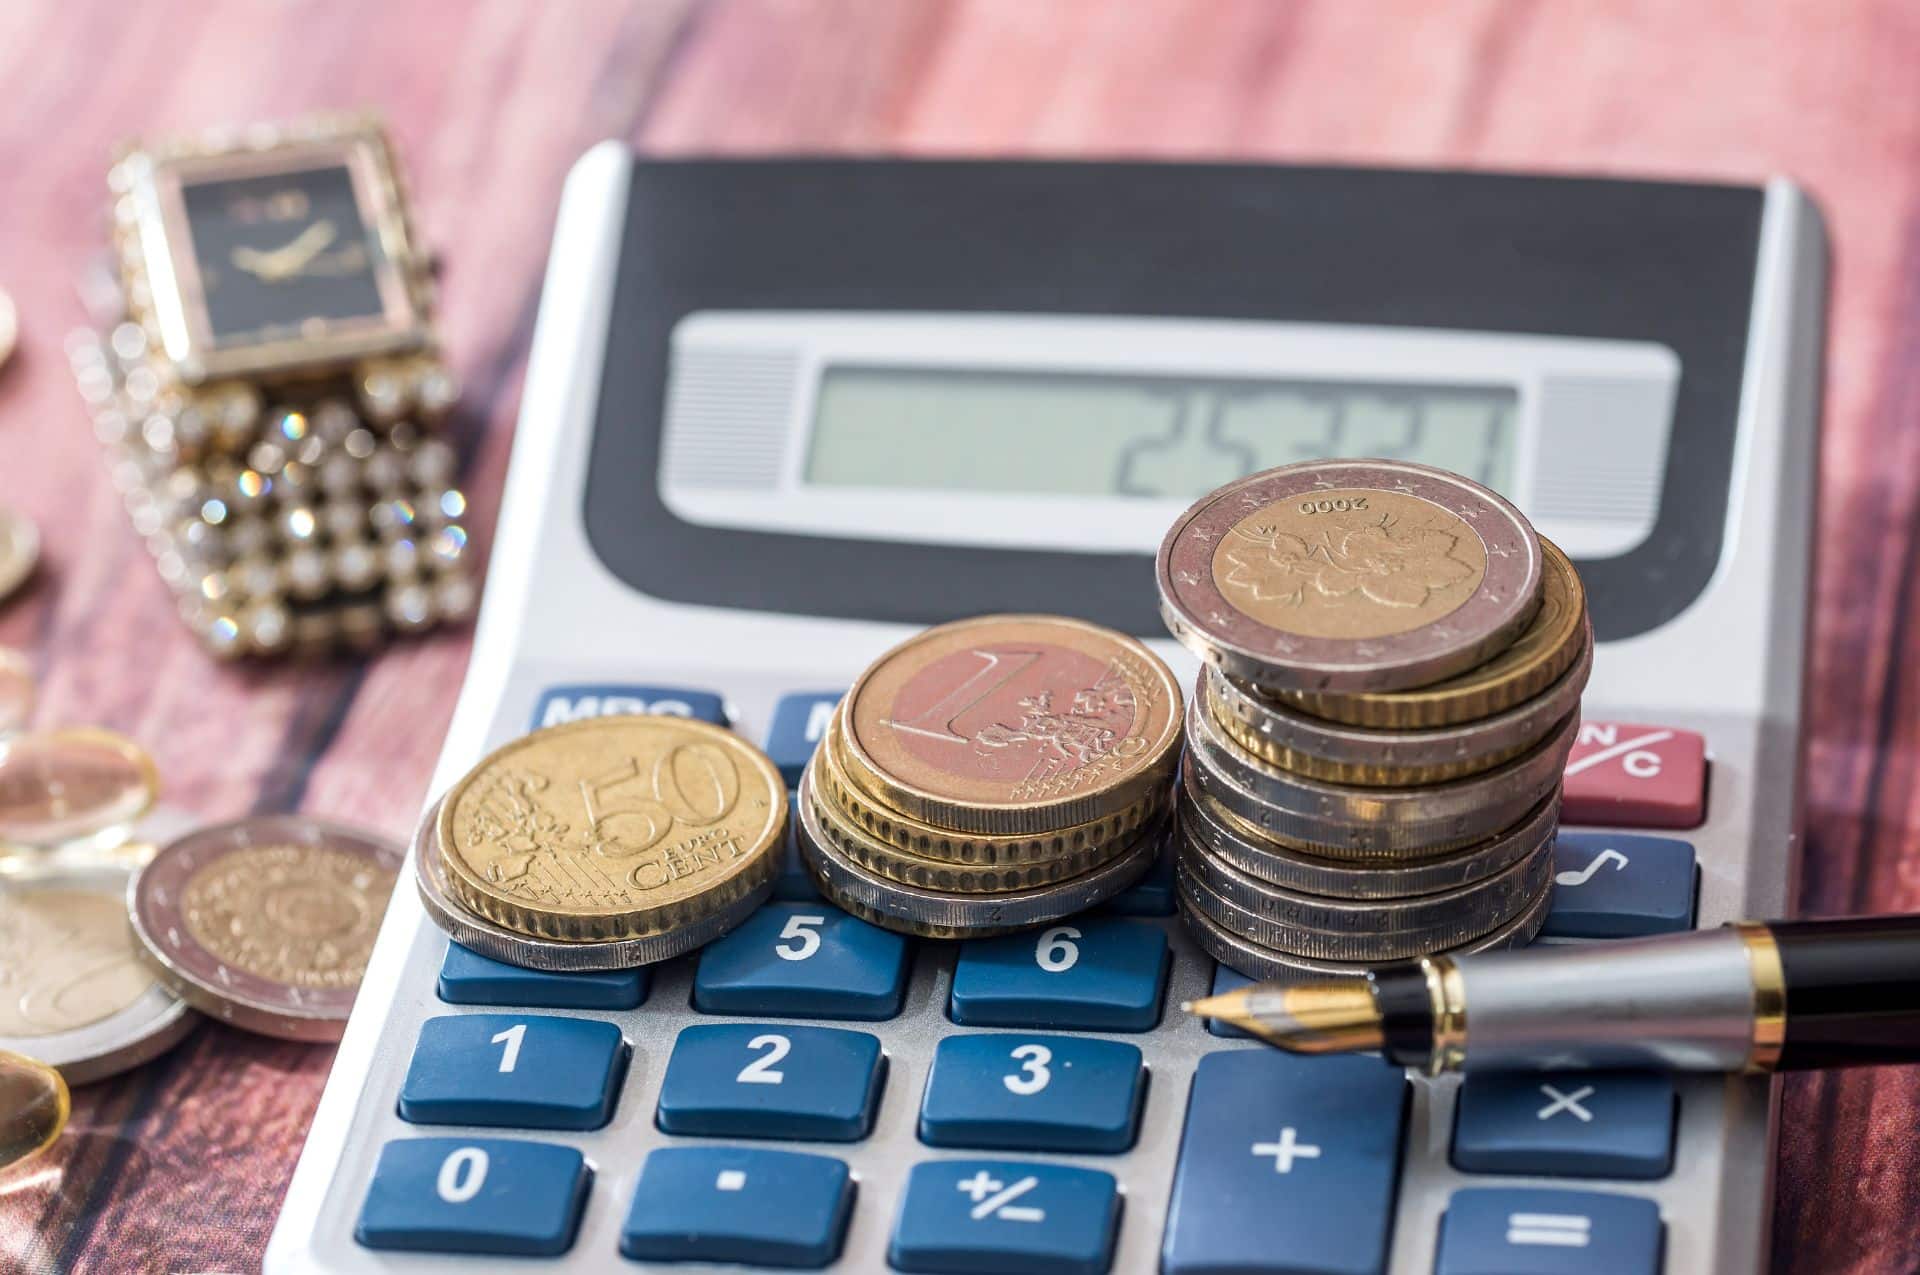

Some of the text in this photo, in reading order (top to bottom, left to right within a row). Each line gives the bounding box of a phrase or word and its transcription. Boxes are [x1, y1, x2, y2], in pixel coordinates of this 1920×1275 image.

[578, 742, 741, 858] 50
[626, 835, 744, 891] CENT
[662, 827, 729, 860] EURO
[775, 914, 826, 962] 5
[1034, 926, 1082, 973] 6
[489, 1024, 528, 1074] 1
[735, 1034, 793, 1085] 2
[1001, 1044, 1053, 1096] 3
[435, 1146, 491, 1203] 0
